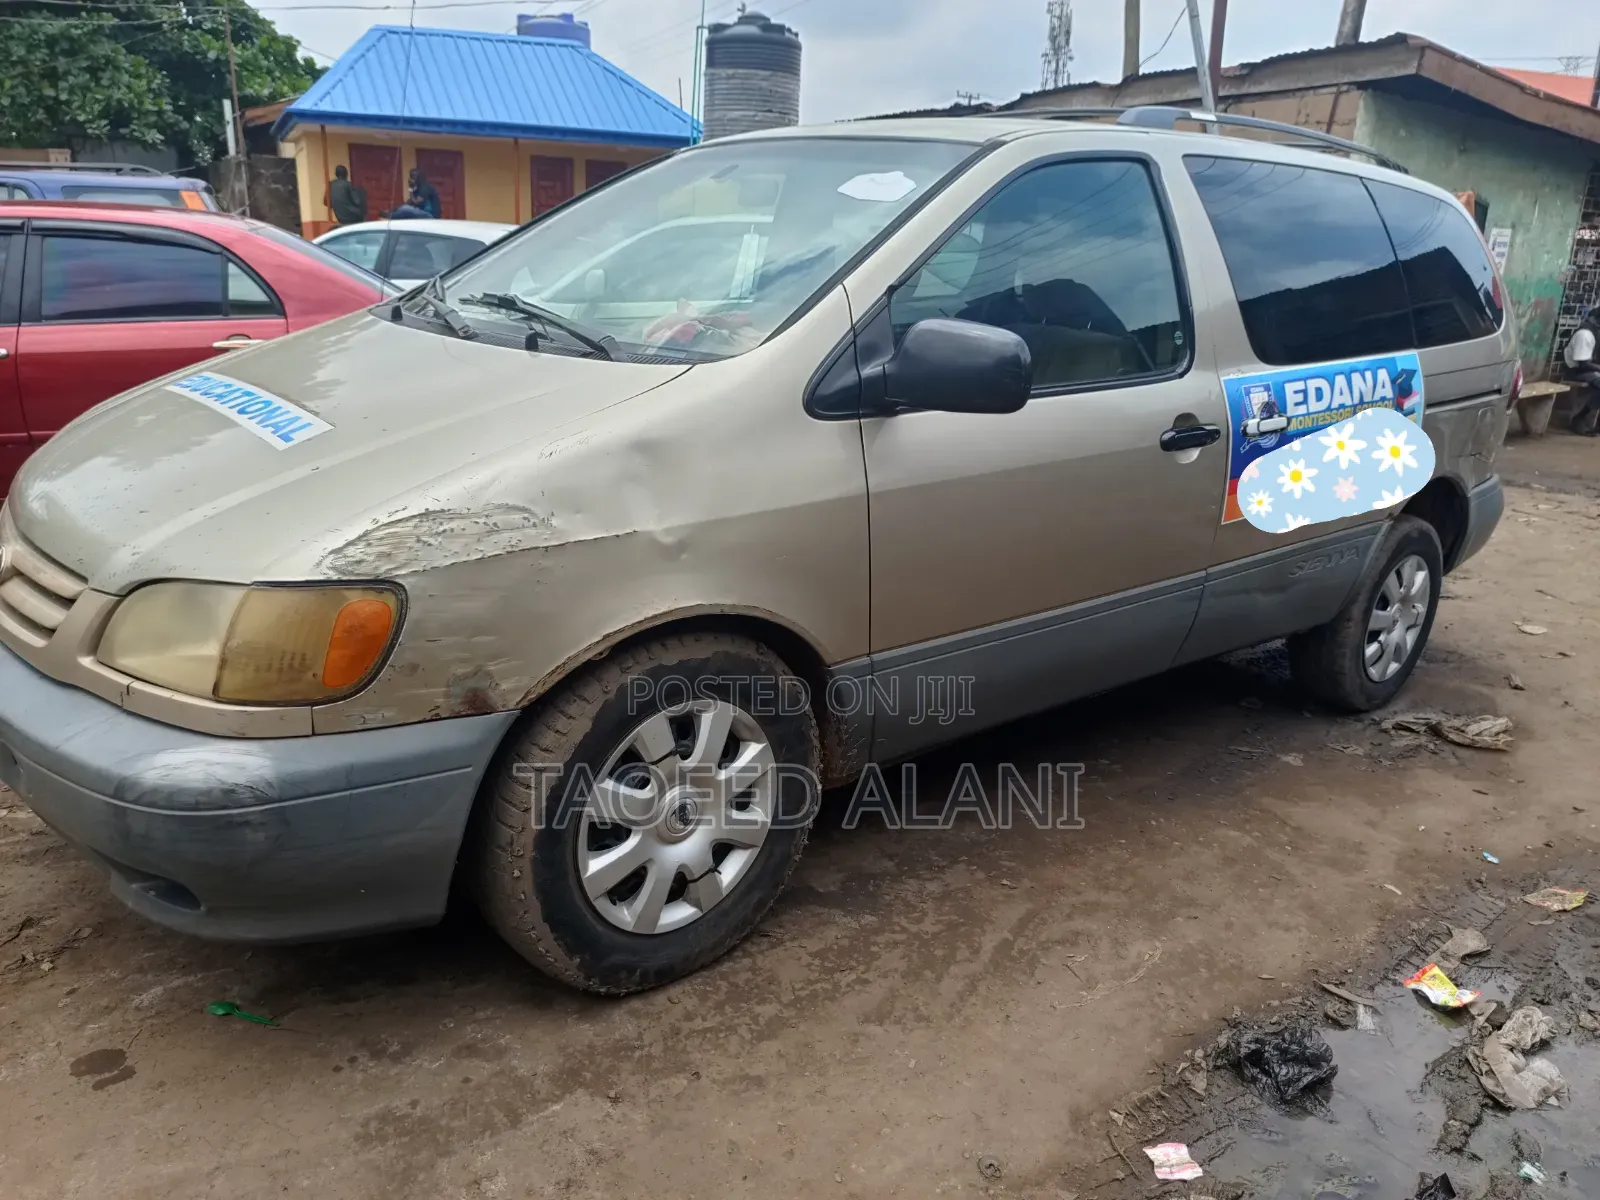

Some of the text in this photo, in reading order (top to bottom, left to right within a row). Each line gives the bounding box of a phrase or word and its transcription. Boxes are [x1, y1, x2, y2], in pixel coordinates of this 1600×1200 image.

[172, 375, 314, 443] EDUCATIONAL
[1284, 368, 1394, 416] EDANA
[1287, 407, 1354, 432] MONTESSORI
